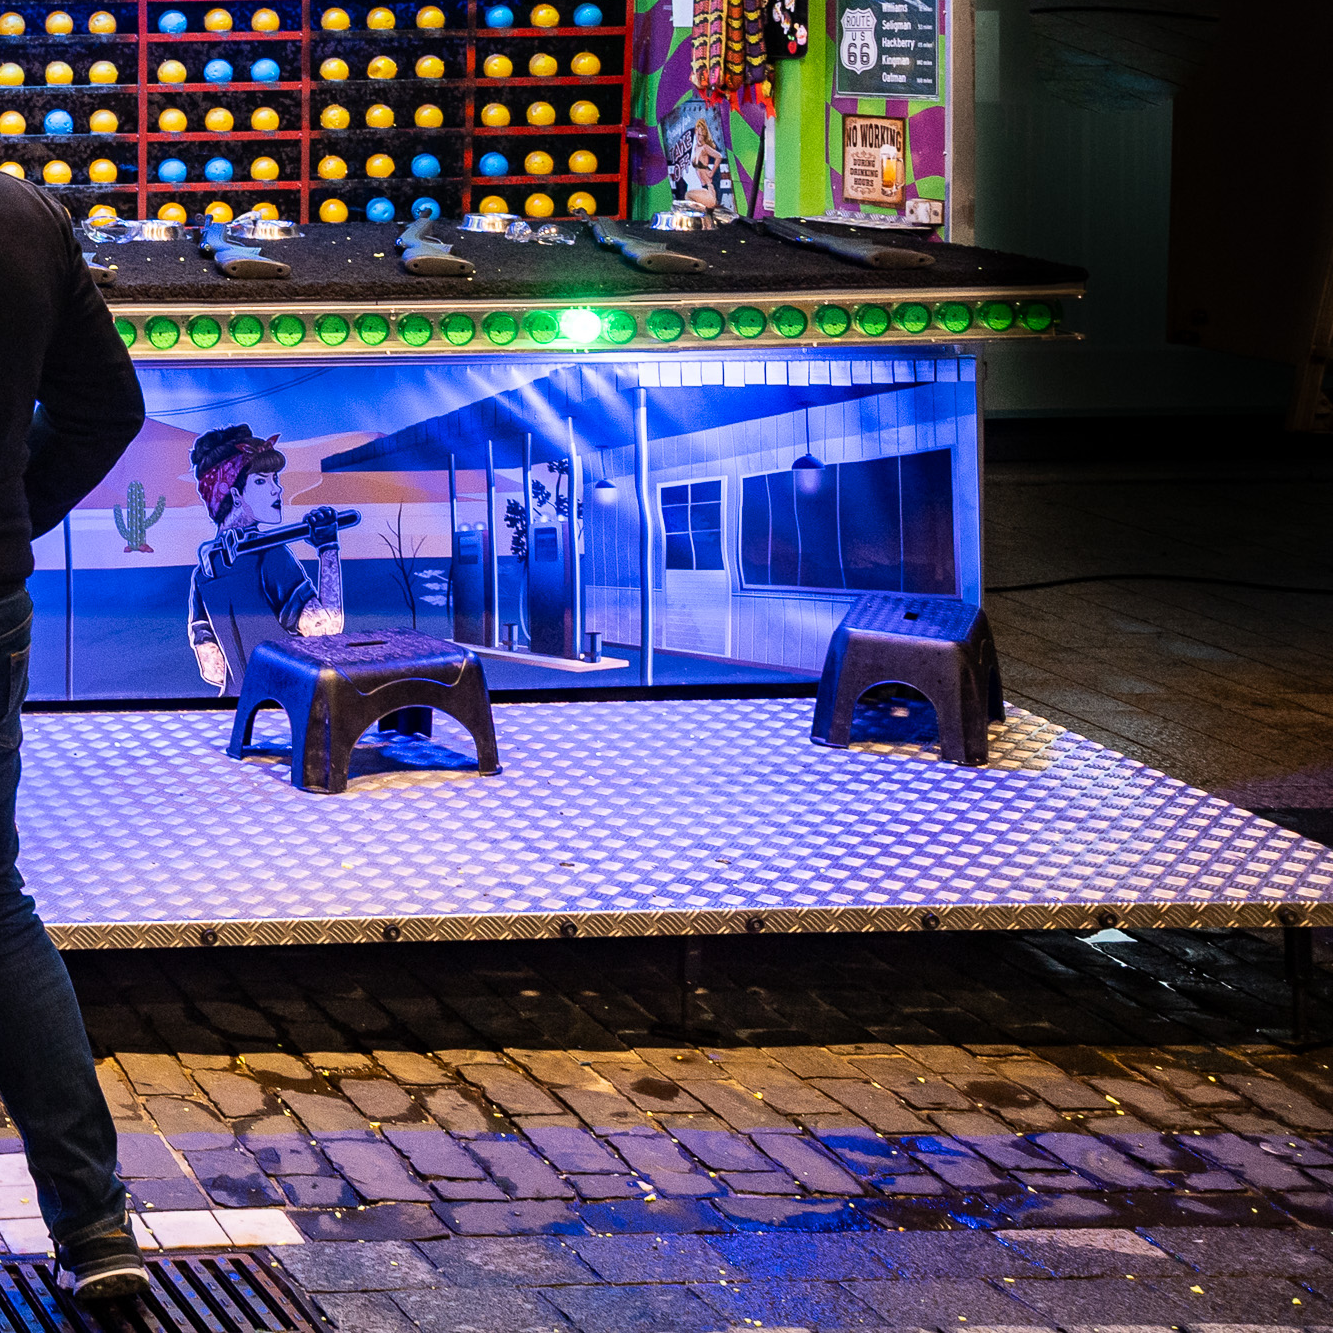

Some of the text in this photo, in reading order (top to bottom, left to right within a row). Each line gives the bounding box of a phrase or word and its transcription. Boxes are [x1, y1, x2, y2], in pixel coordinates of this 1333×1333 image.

[846, 16, 871, 27] ROUTE
[882, 20, 912, 32] Seligman
[882, 37, 915, 50] Hackberry
[847, 43, 870, 66] 66
[882, 55, 910, 68] Kingman
[846, 123, 902, 152] NO WORKING
